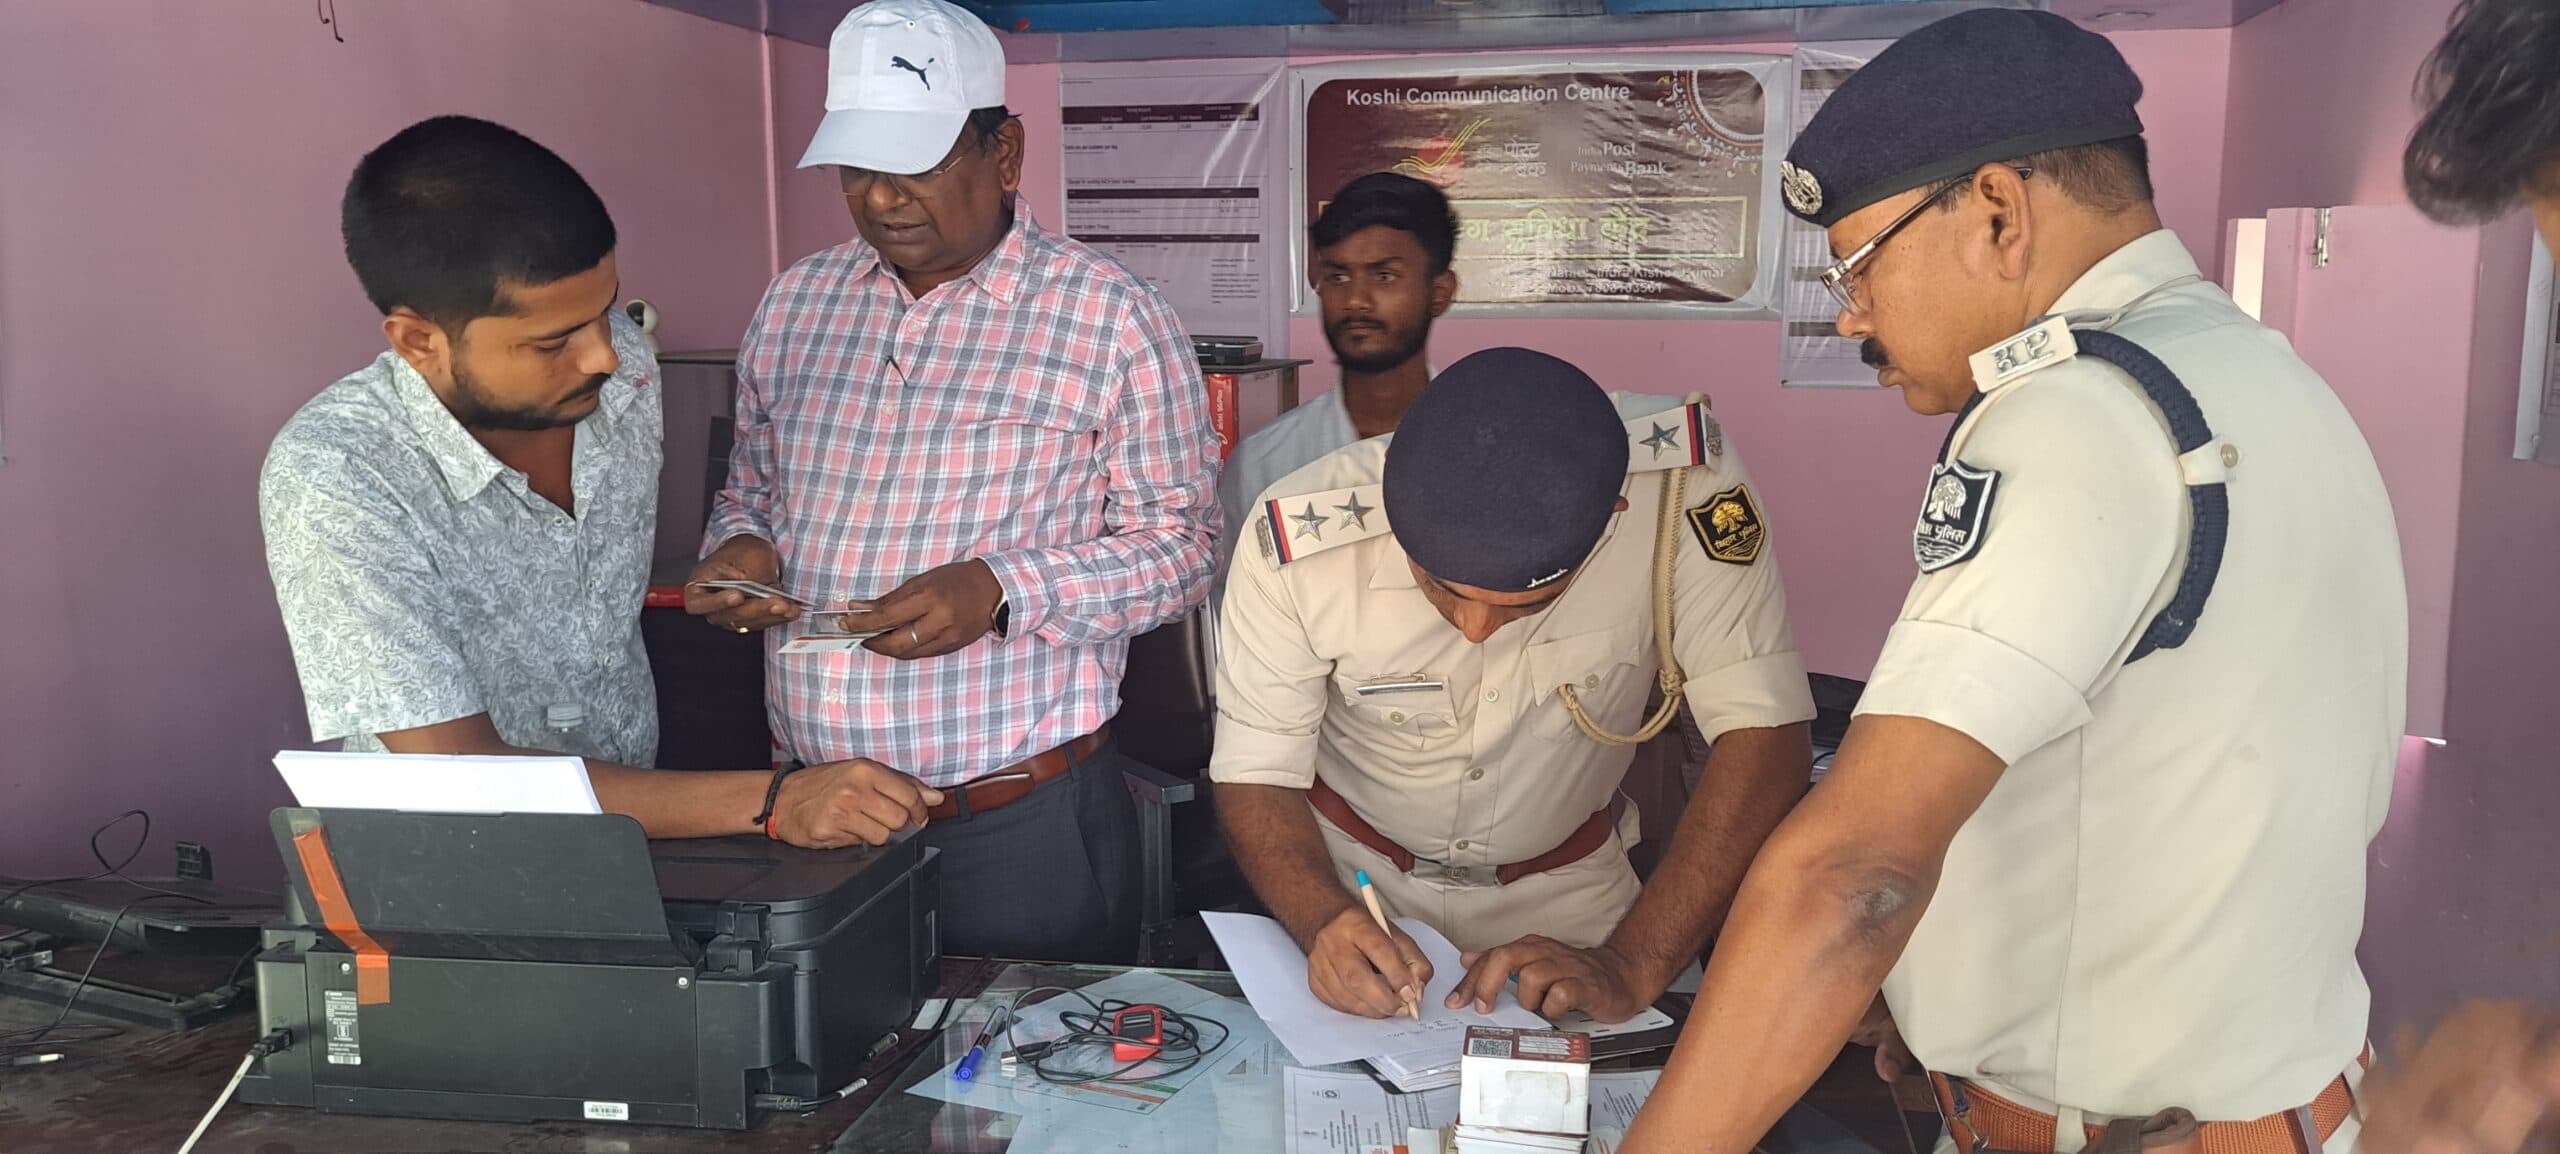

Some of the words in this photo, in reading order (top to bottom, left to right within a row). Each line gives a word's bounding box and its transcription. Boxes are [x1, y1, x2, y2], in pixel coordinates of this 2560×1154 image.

[1346, 87, 1400, 105] Koshi
[1406, 84, 1558, 105] Communication
[1564, 83, 1631, 101] Centre
[1603, 142, 1638, 156] Post
[1624, 161, 1666, 176] Bank
